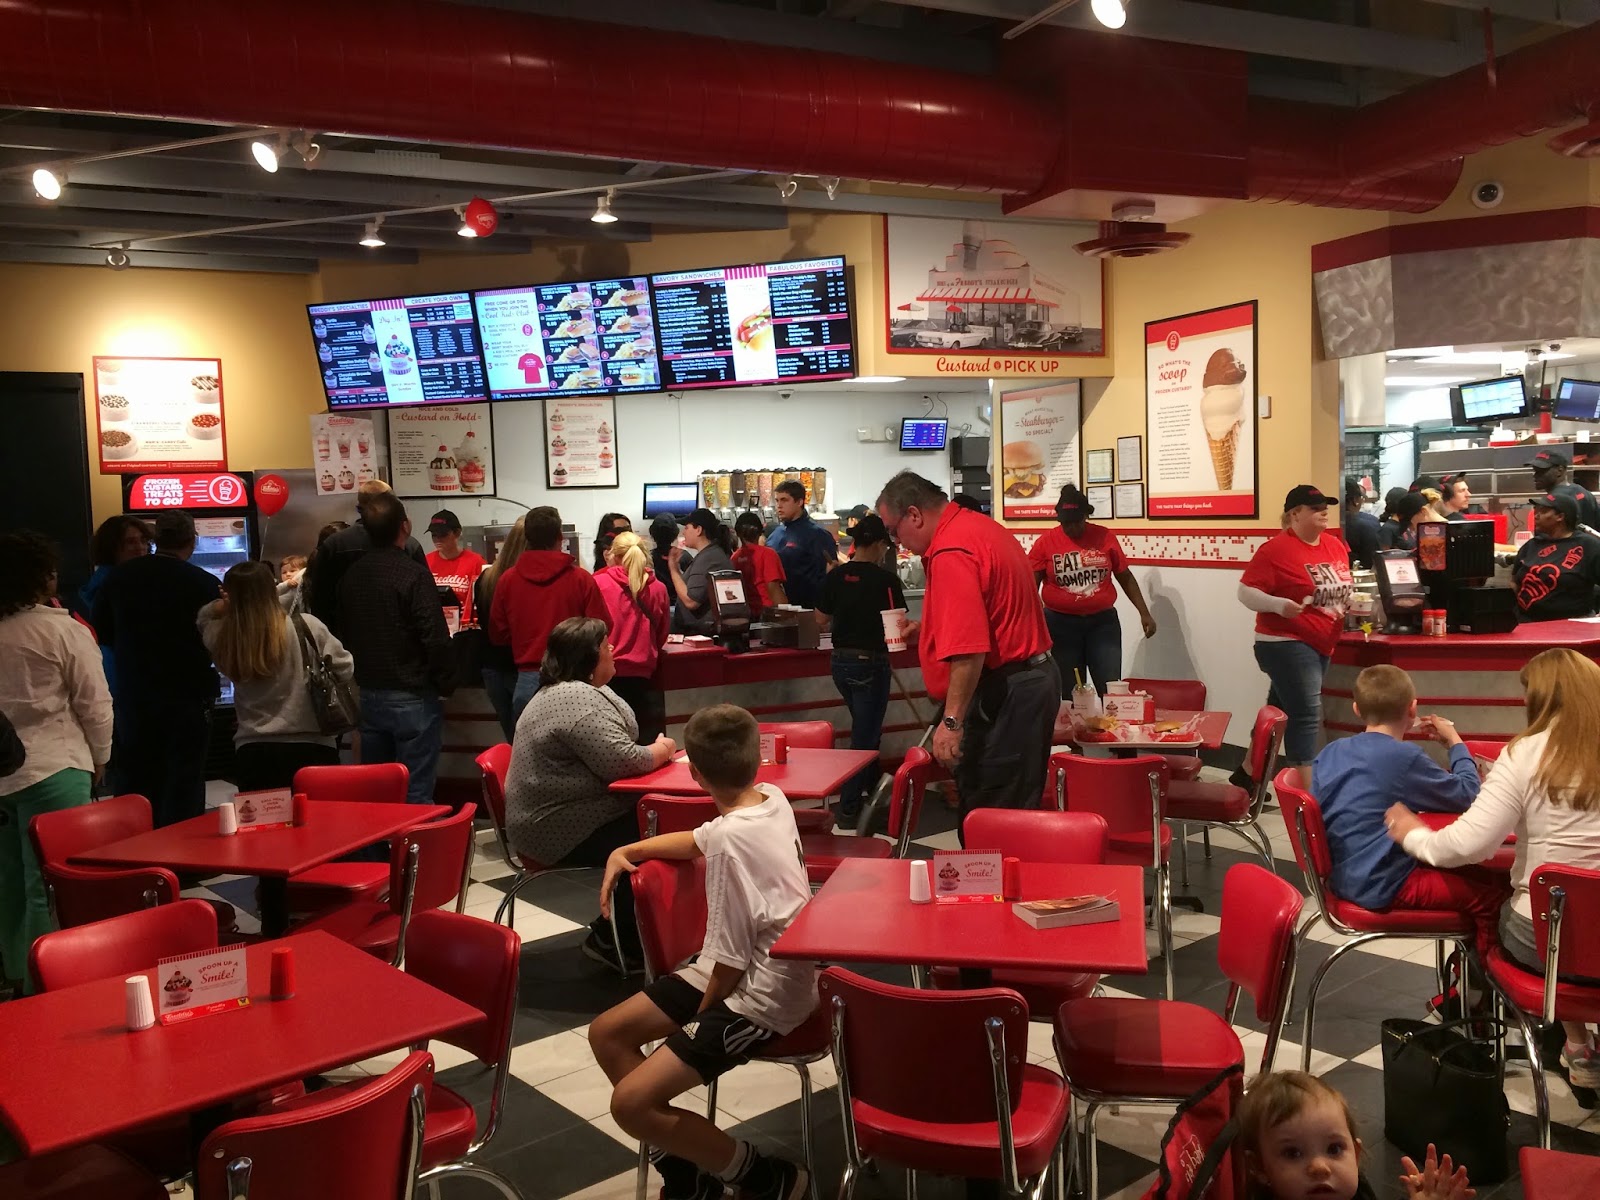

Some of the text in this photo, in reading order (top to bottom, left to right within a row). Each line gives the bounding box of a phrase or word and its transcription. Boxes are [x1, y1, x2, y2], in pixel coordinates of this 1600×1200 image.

[936, 356, 1059, 372] Custard PICK UP
[1159, 369, 1187, 382] scoop
[401, 412, 437, 421] Custard
[452, 413, 476, 421] Hold
[1020, 415, 1058, 427] Steakburger
[145, 497, 184, 506] TO GO!
[1054, 551, 1079, 573] EAT
[1306, 564, 1337, 585] EAT
[966, 869, 993, 877] Smile!
[198, 962, 222, 973] SPOON
[200, 968, 235, 984] Smile!
